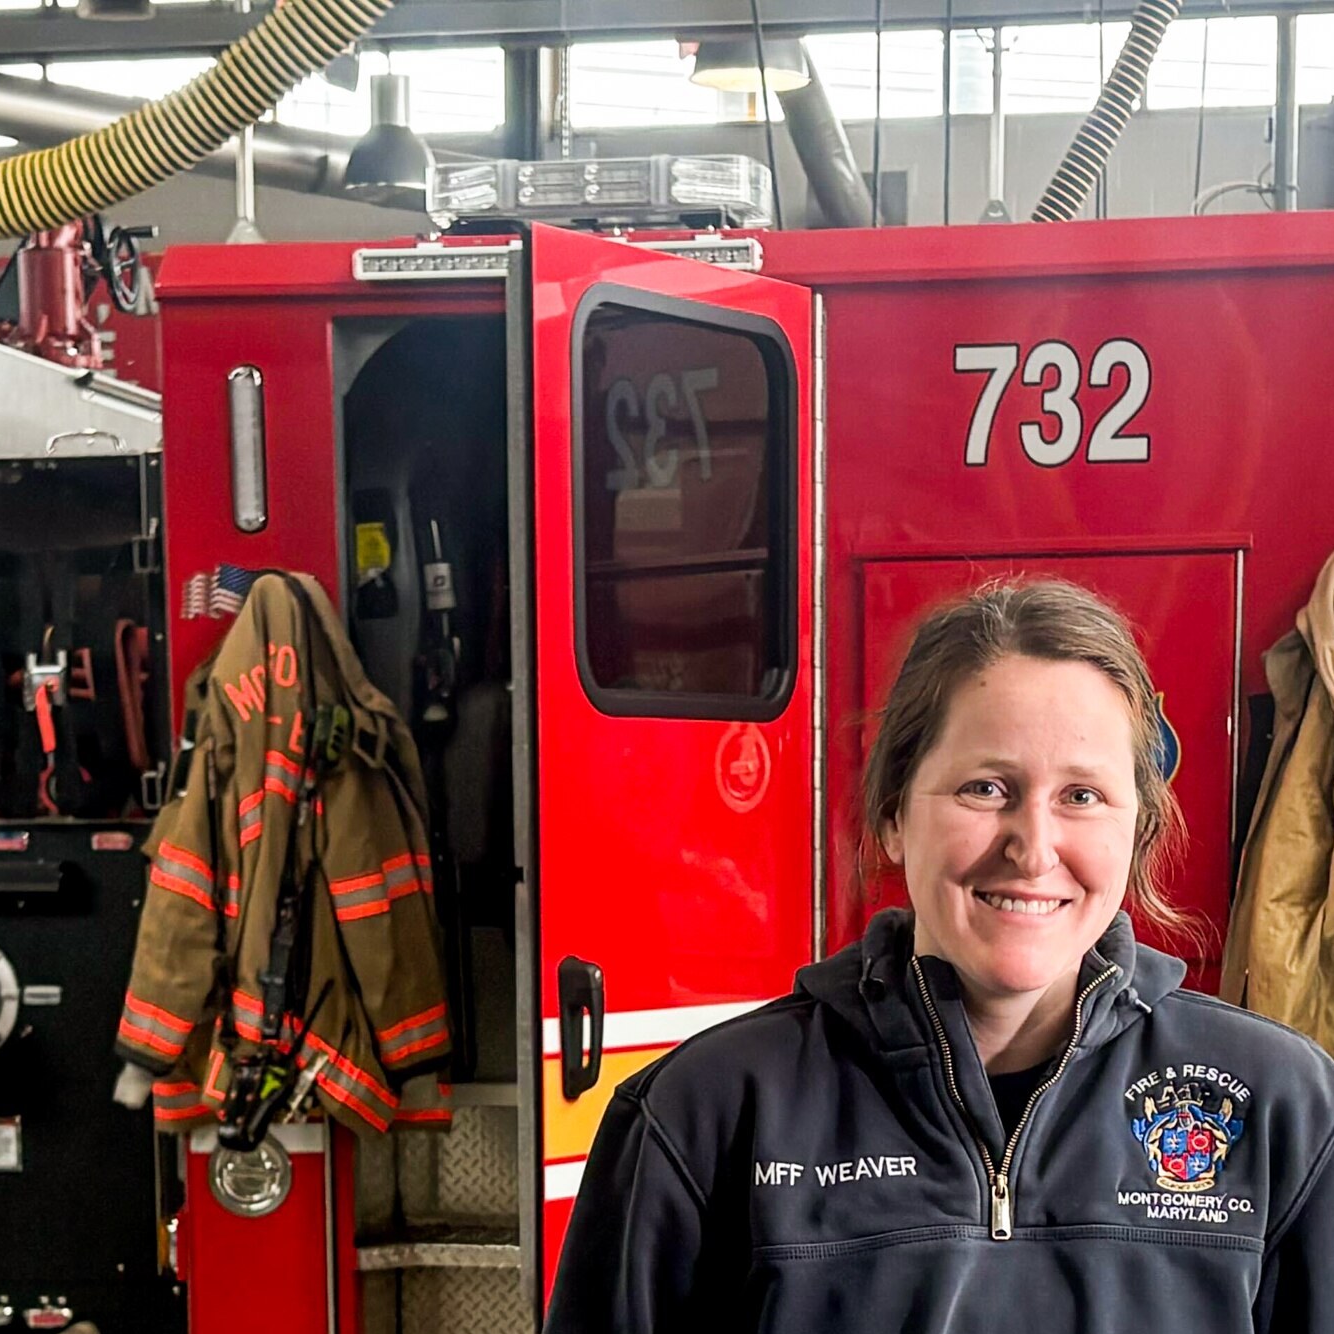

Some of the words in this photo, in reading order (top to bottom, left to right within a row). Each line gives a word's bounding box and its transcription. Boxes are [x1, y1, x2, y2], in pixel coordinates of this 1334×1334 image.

[953, 337, 1152, 468] 732
[1124, 1071, 1162, 1102] FIRE
[1165, 1066, 1177, 1079] &
[1183, 1063, 1251, 1103] RESCUE
[754, 1161, 805, 1187] MFF
[815, 1156, 918, 1188] WEAVER
[1117, 1191, 1226, 1210] MONTGOMERY
[1227, 1197, 1255, 1214] CO.
[1146, 1205, 1229, 1224] MARYLAND
